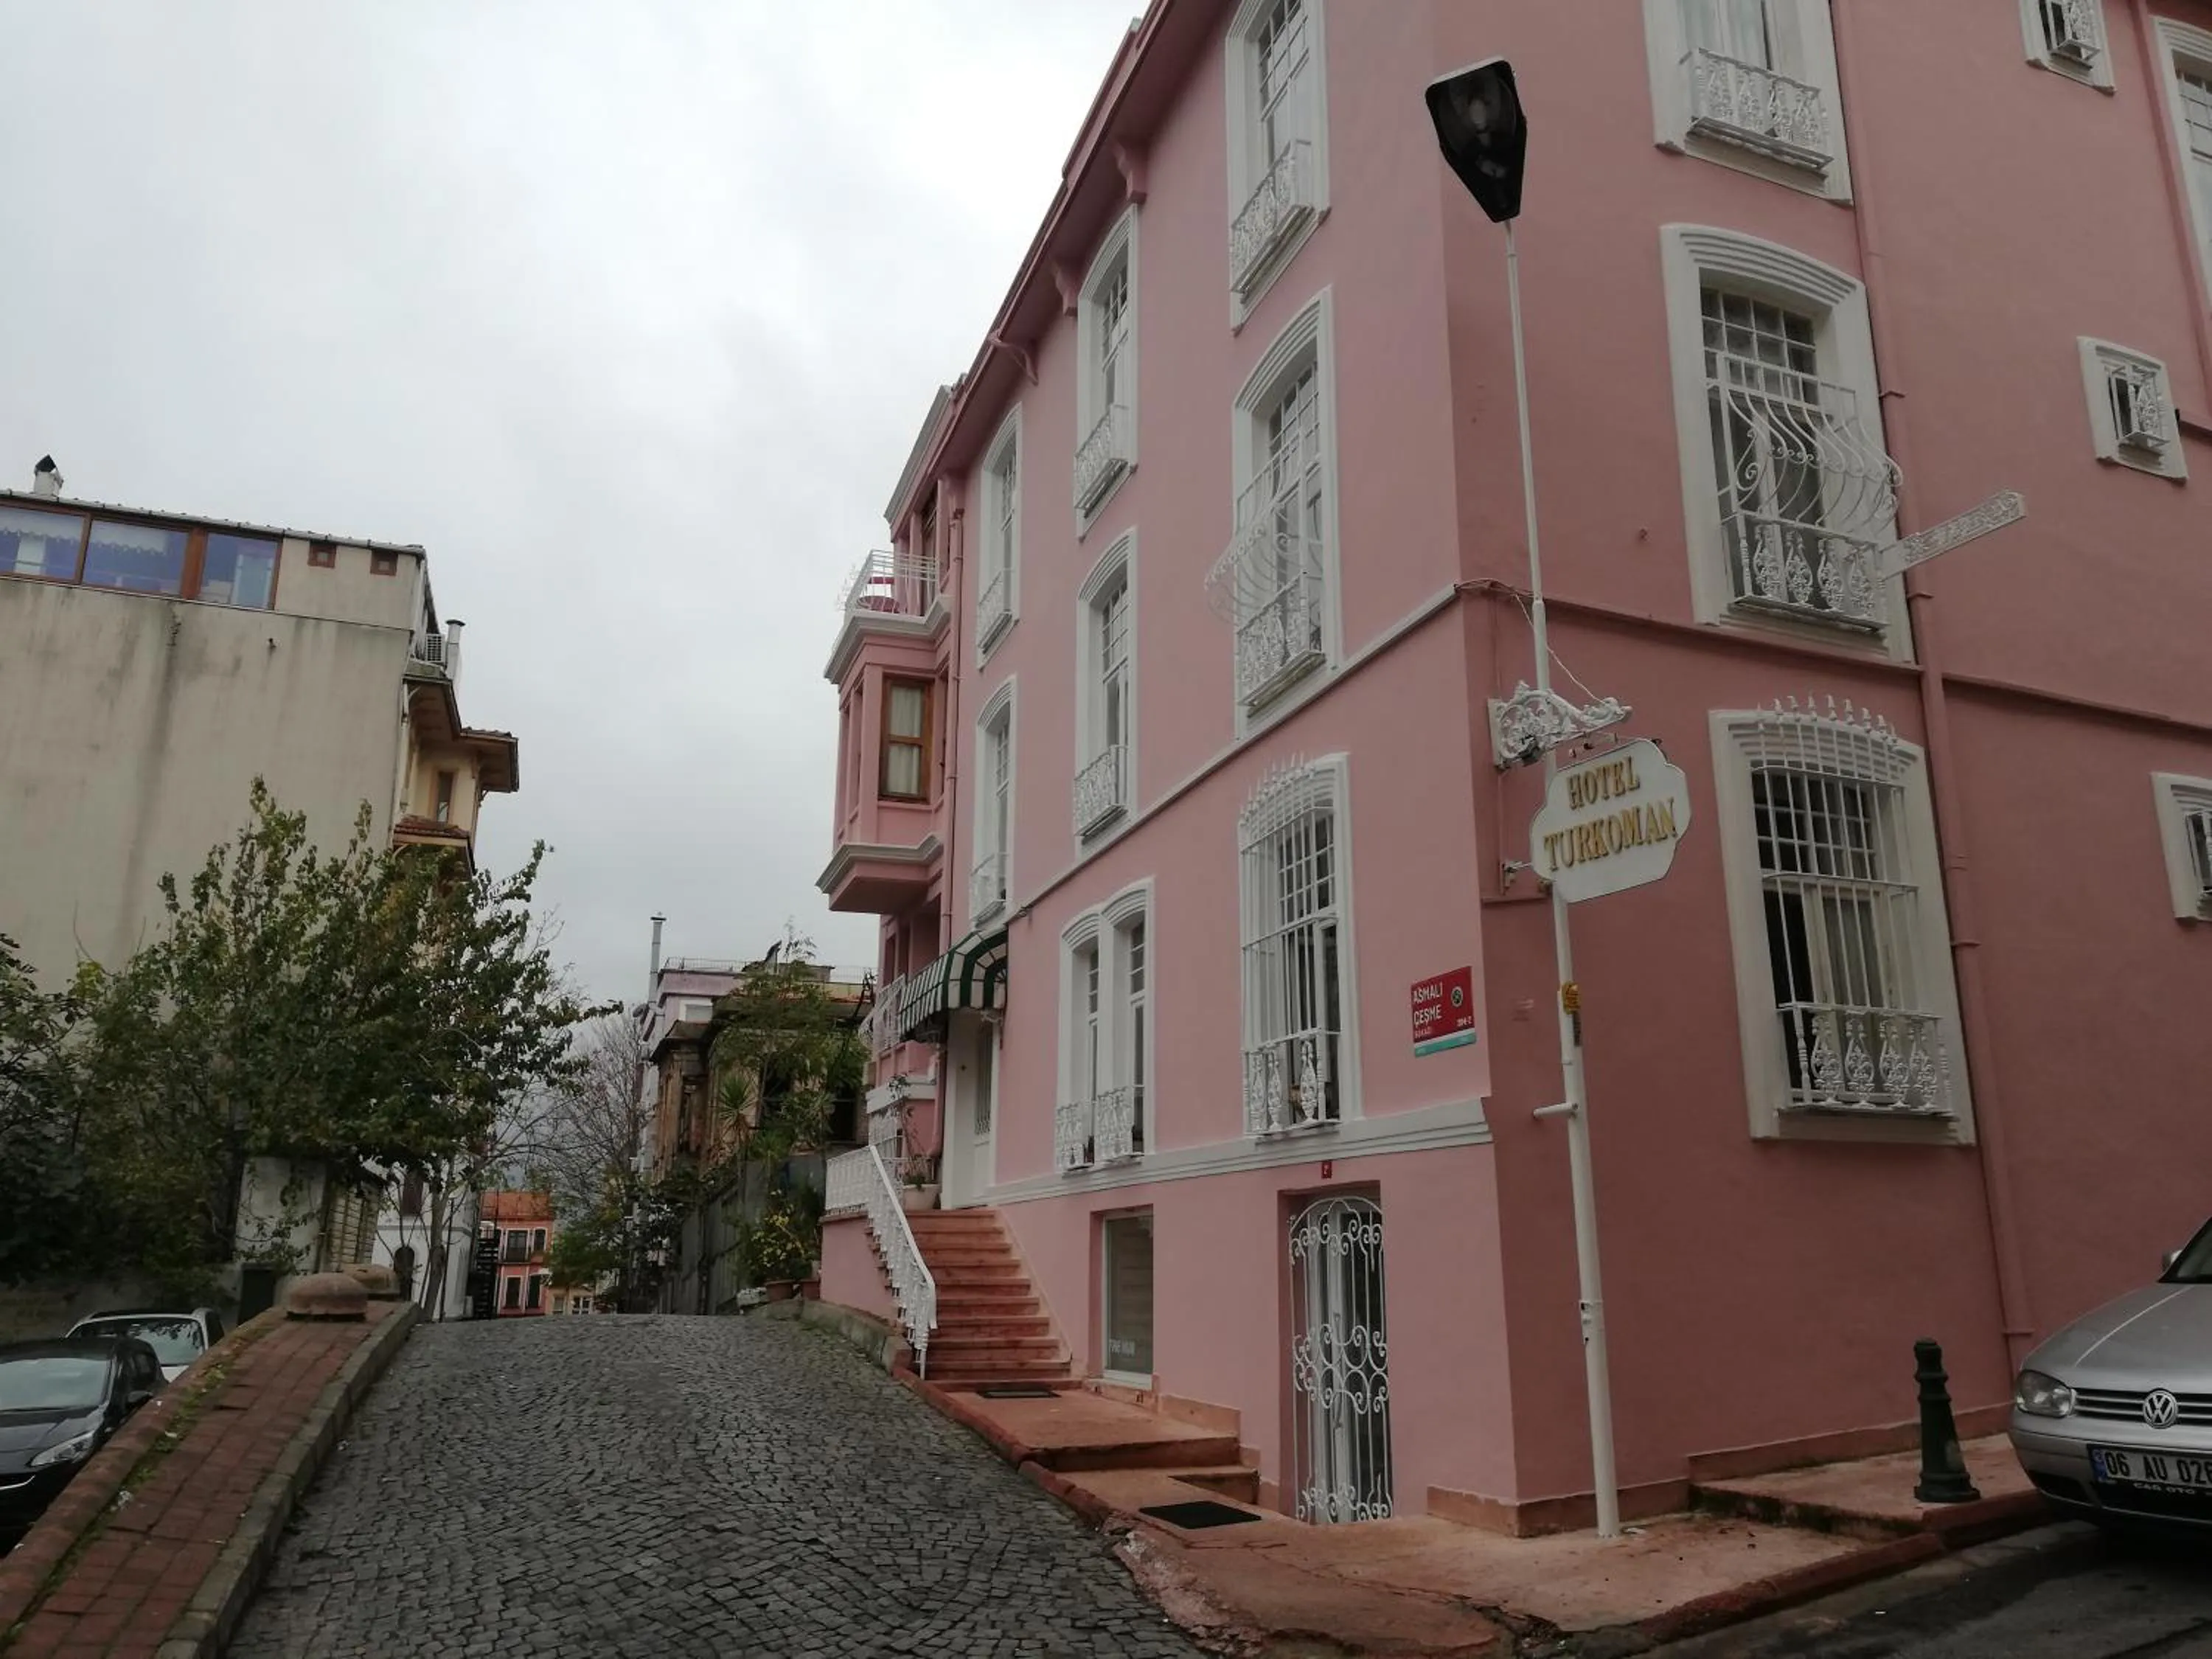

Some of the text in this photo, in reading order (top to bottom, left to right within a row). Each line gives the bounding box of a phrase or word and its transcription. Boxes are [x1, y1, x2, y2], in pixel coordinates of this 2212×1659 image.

[1568, 756, 1641, 810] HOTEL
[1543, 797, 1677, 871] TURKOMAN
[1413, 981, 1443, 1004] ASMALI
[2104, 1451, 2130, 1476] 06
[2143, 1455, 2168, 1481] AU
